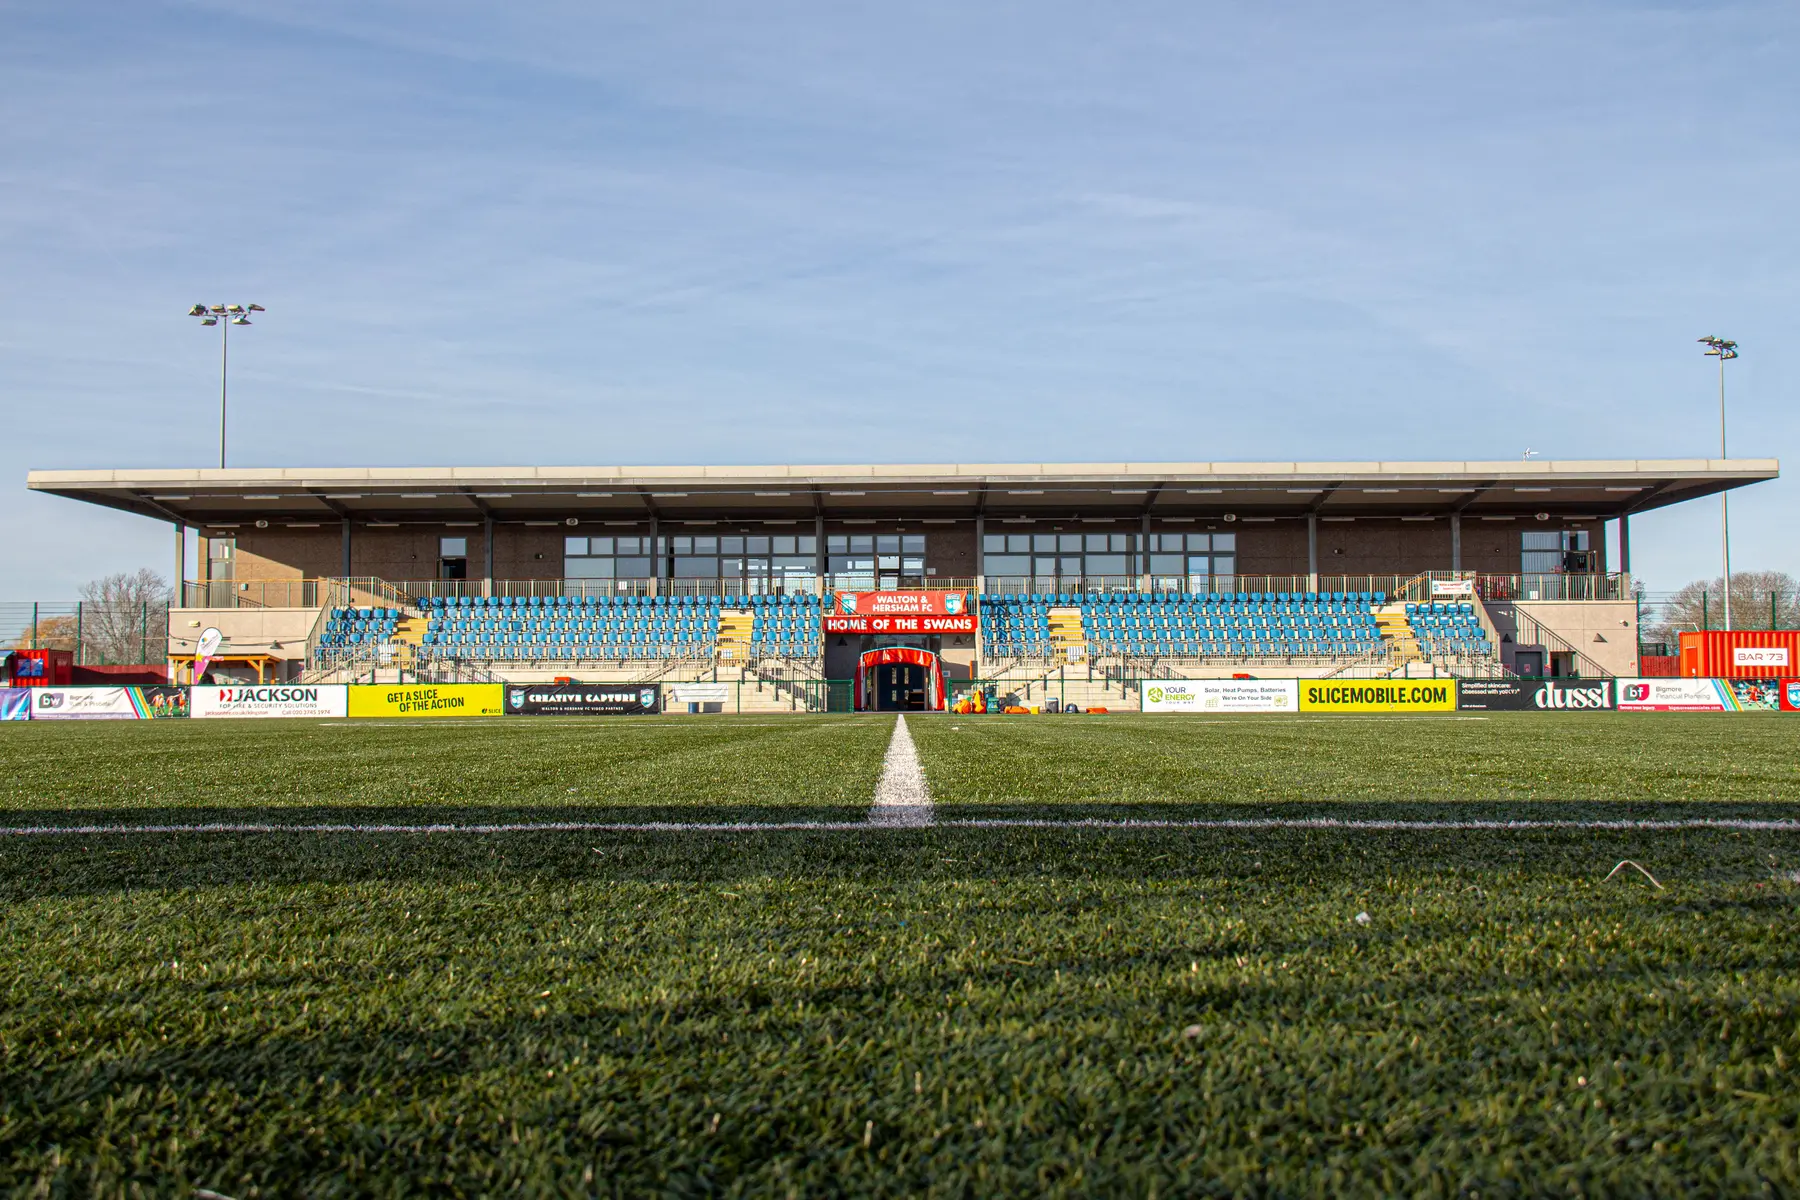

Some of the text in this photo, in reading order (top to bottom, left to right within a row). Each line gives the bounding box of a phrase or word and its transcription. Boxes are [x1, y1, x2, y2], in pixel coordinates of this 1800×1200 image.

[872, 604, 932, 612] HERSHAM FC
[827, 620, 972, 630] HOME OF THE SWANS
[1738, 653, 1763, 661] BAR
[234, 689, 318, 702] JACKSON
[387, 689, 438, 704] GET A SLICE
[1165, 693, 1195, 701] ENERGY
[1308, 687, 1447, 703] SLICEMOBILE.COM
[1629, 687, 1643, 698] bf
[43, 696, 61, 705] bw
[528, 693, 636, 703] CREATIVE CAPTURE
[399, 697, 465, 712] OF THE ACTION
